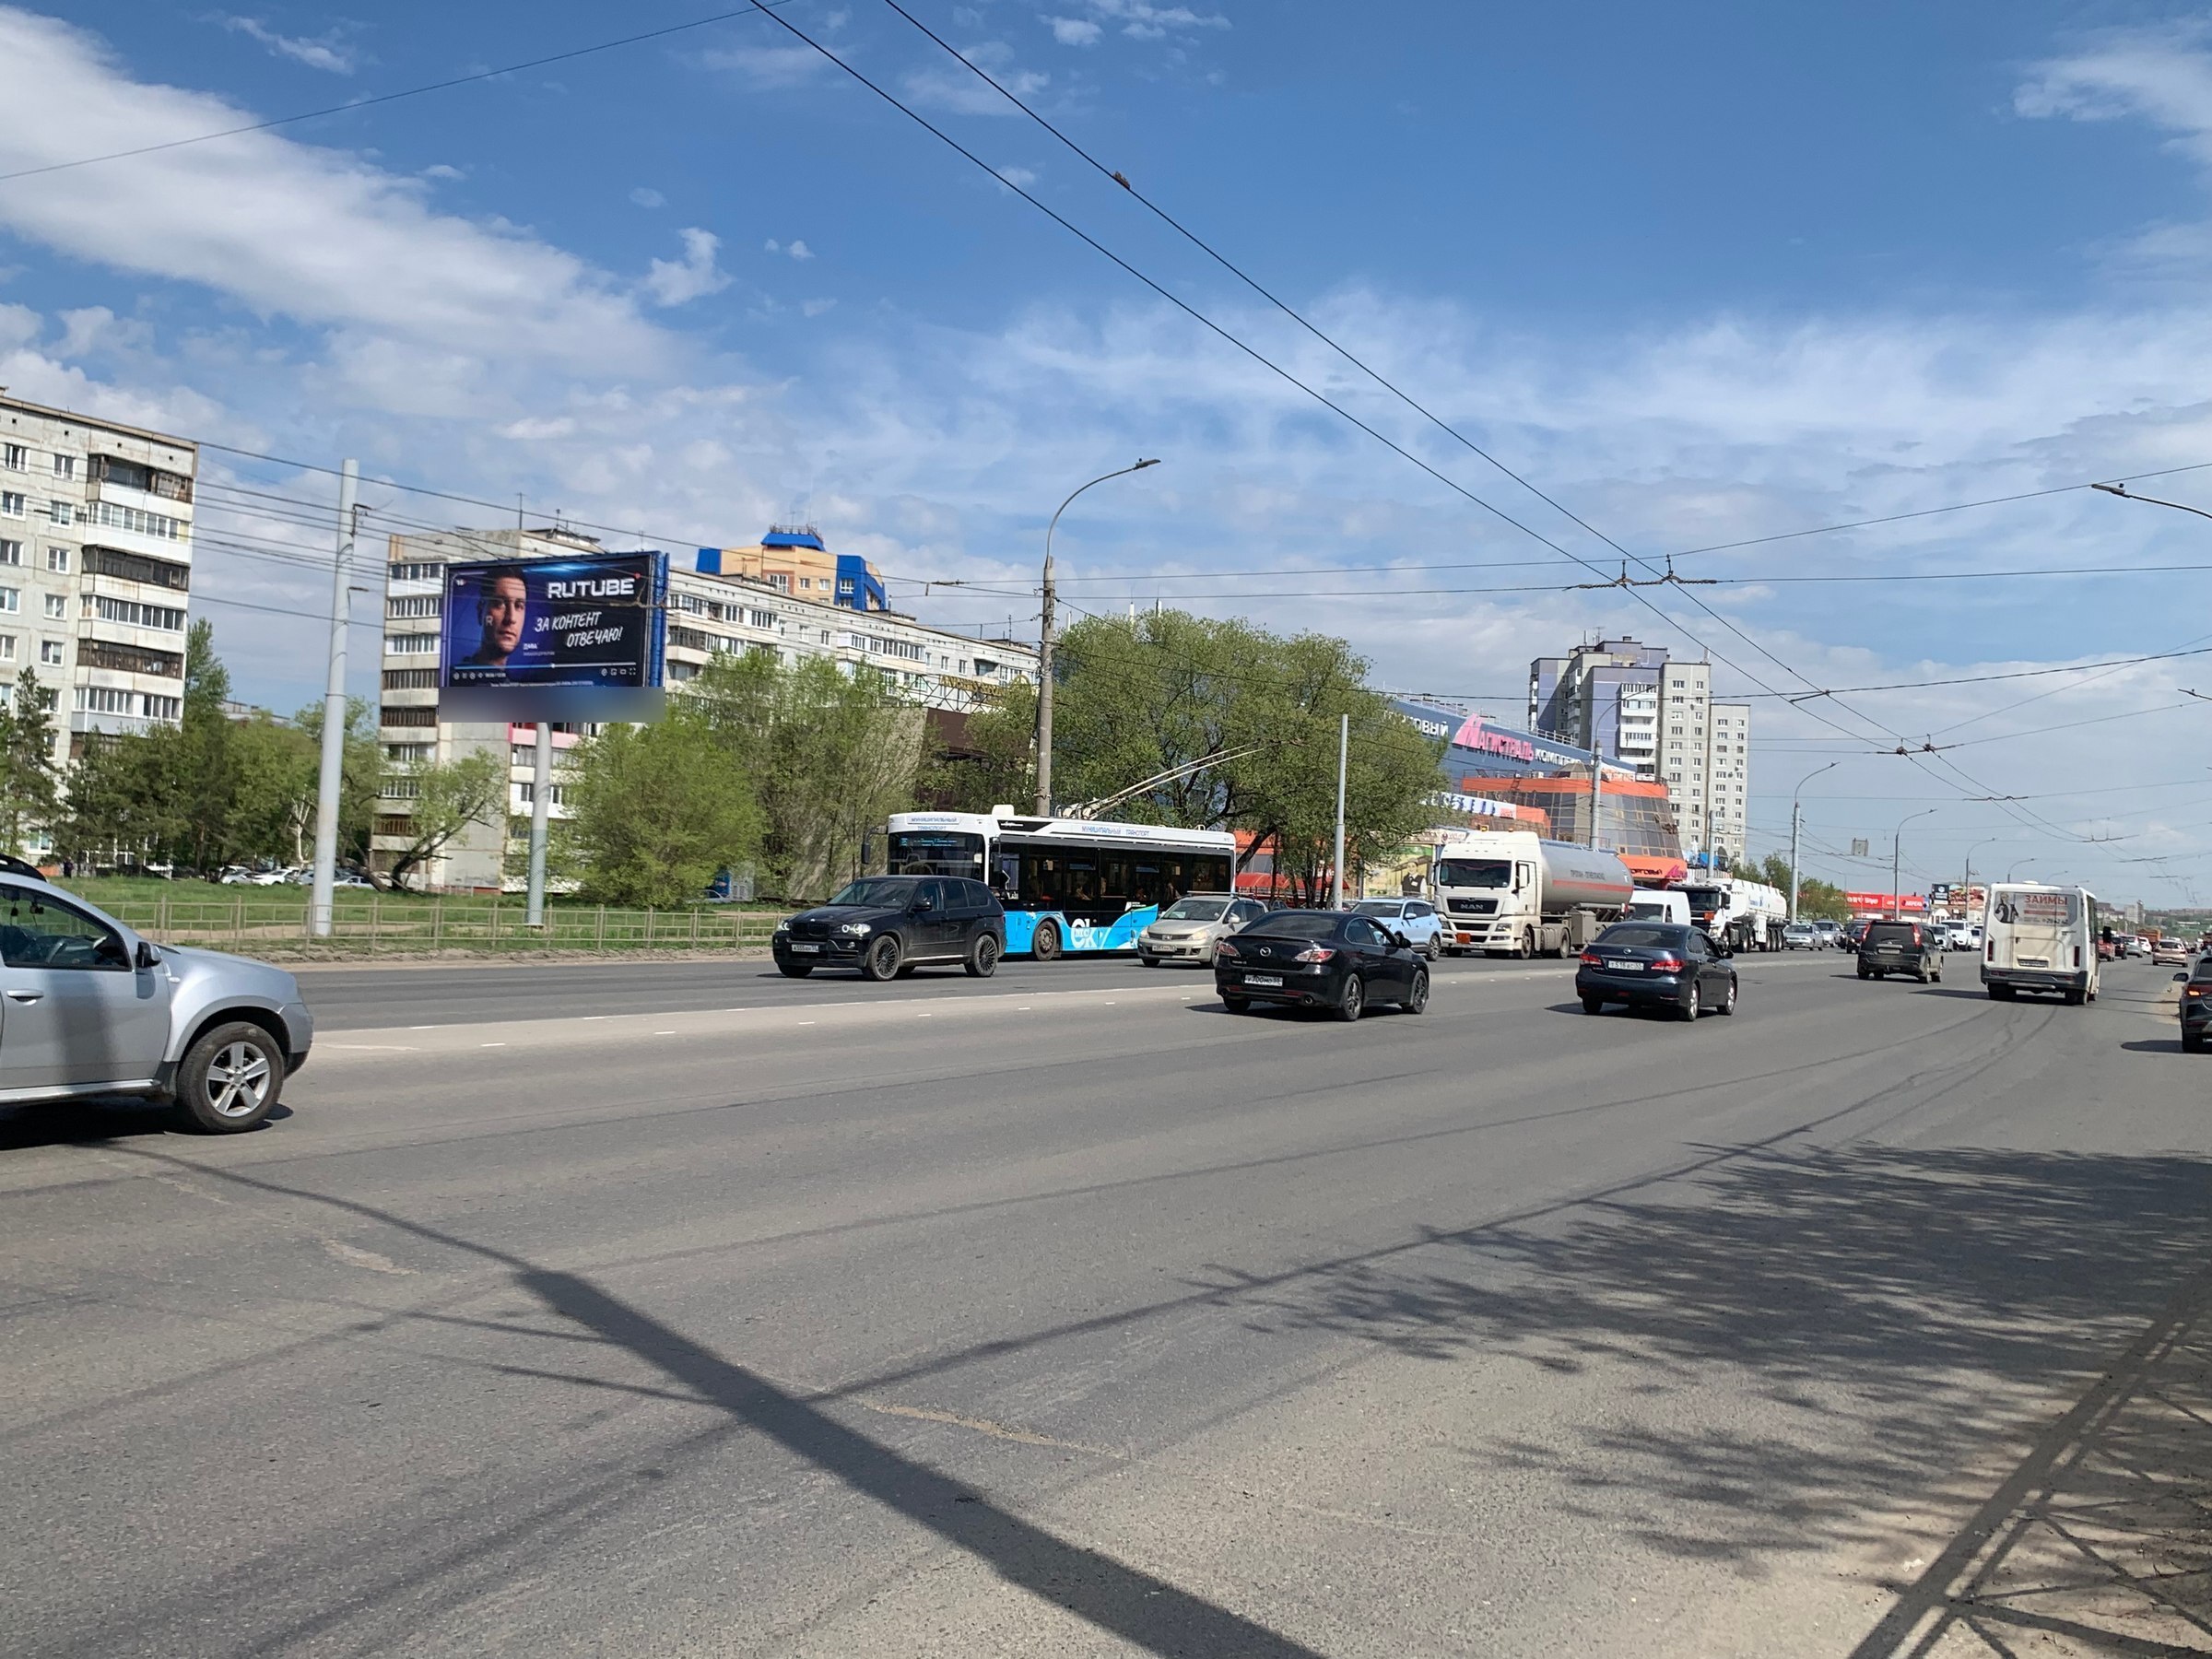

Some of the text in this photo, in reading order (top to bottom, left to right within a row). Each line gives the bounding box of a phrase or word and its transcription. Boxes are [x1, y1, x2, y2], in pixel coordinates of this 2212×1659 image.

[547, 578, 635, 598] RUTUBE
[535, 612, 602, 632] ЗА КОНТЕНТ
[567, 627, 623, 647] ОТВЕЧАЮ!
